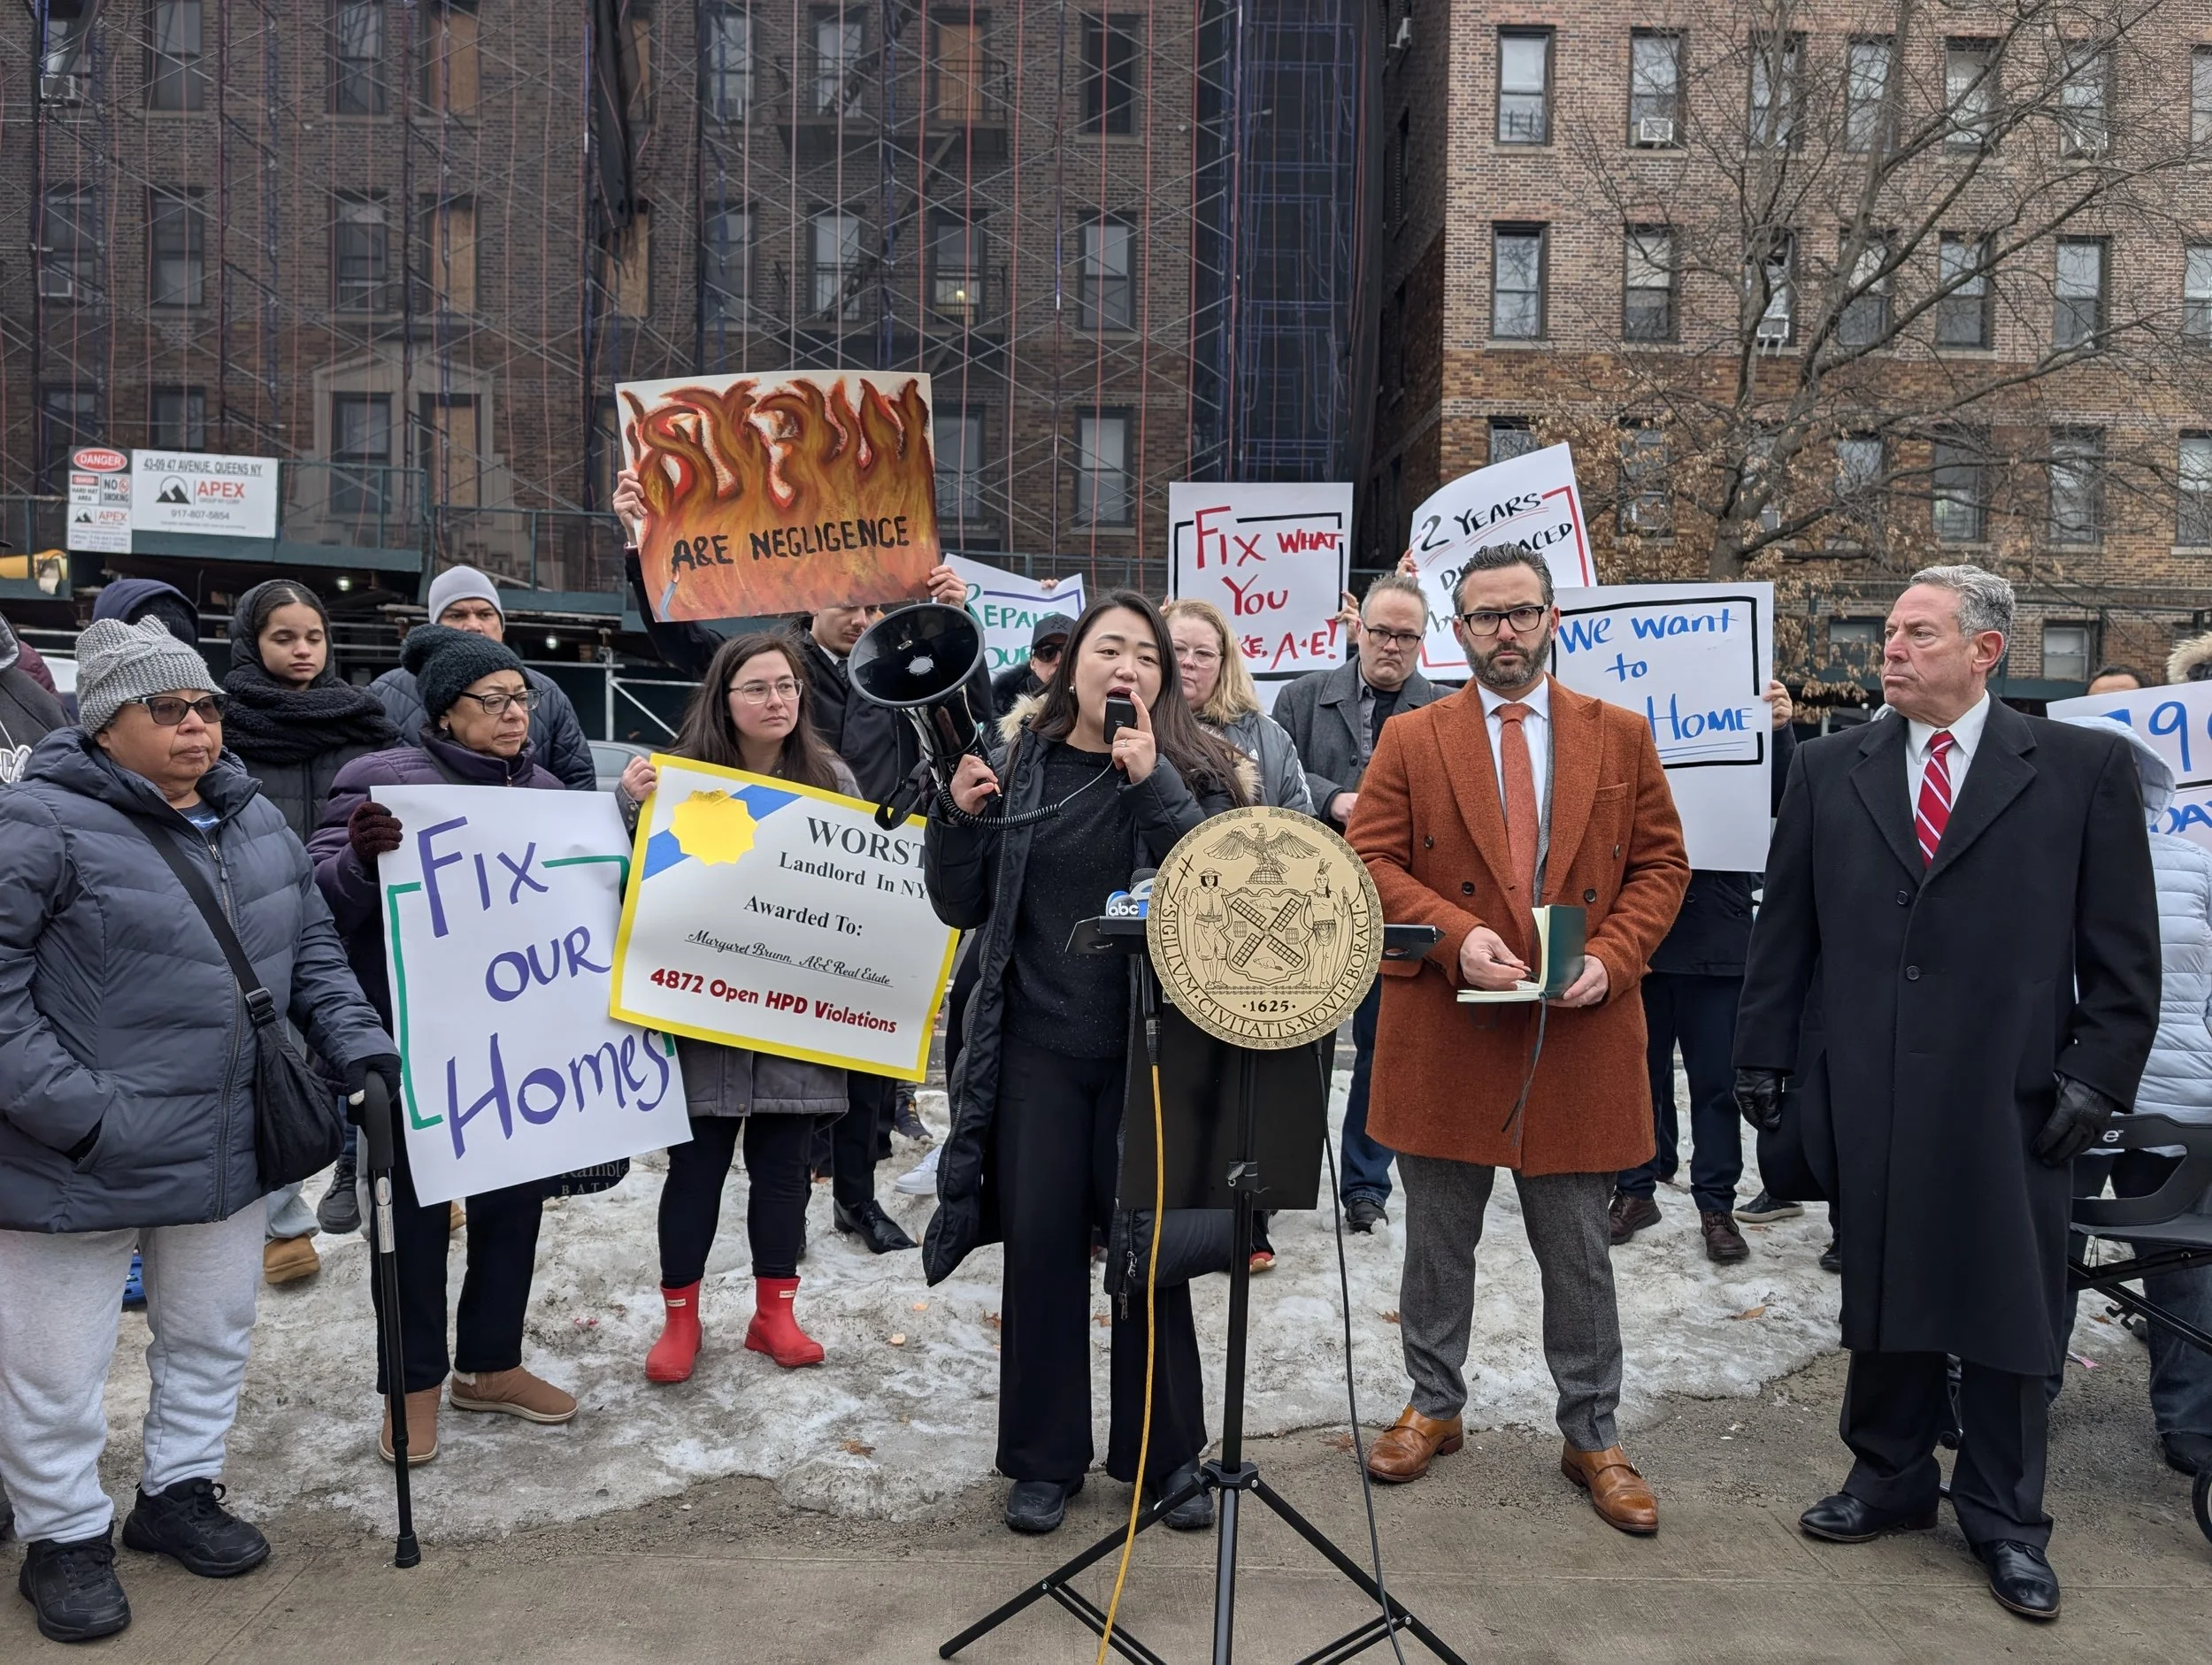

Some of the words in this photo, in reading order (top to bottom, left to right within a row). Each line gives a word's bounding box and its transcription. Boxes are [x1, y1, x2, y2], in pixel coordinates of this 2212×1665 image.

[80, 454, 121, 466] DANGER
[144, 457, 165, 471] 43-09
[166, 460, 177, 471] 47
[215, 463, 249, 475] QUEENS
[250, 464, 263, 475] NY
[104, 479, 118, 490] NO
[104, 493, 129, 503] SMOKING
[197, 480, 245, 498] APEX
[99, 510, 127, 523] APEX
[1420, 514, 1450, 552] 2
[1453, 492, 1542, 536] YEARS
[671, 534, 733, 573] A&E
[749, 516, 910, 561] NEGLIGENCE
[1277, 528, 1344, 554] WHAT
[965, 583, 1060, 629] REPAI
[1559, 618, 1614, 654] We
[1630, 609, 1739, 640] want
[1604, 652, 1647, 682] to
[806, 816, 926, 871] WORST
[779, 850, 865, 886] Landlord
[876, 873, 895, 893] In
[901, 879, 928, 901] NY
[743, 894, 829, 929] Awarded
[835, 914, 863, 938] To:
[1108, 902, 1140, 917] abc
[687, 929, 749, 955] Margaret
[799, 955, 833, 972] A&E
[833, 961, 860, 980] Real
[861, 968, 891, 986] Estate
[1198, 997, 1297, 1039] CIVITATIS
[1300, 989, 1346, 1030] NOVI
[1341, 909, 1369, 993] EBORACI
[650, 968, 704, 994] 4872
[709, 978, 759, 1004] Open
[764, 990, 808, 1015] HPD
[814, 1000, 898, 1034] Violations
